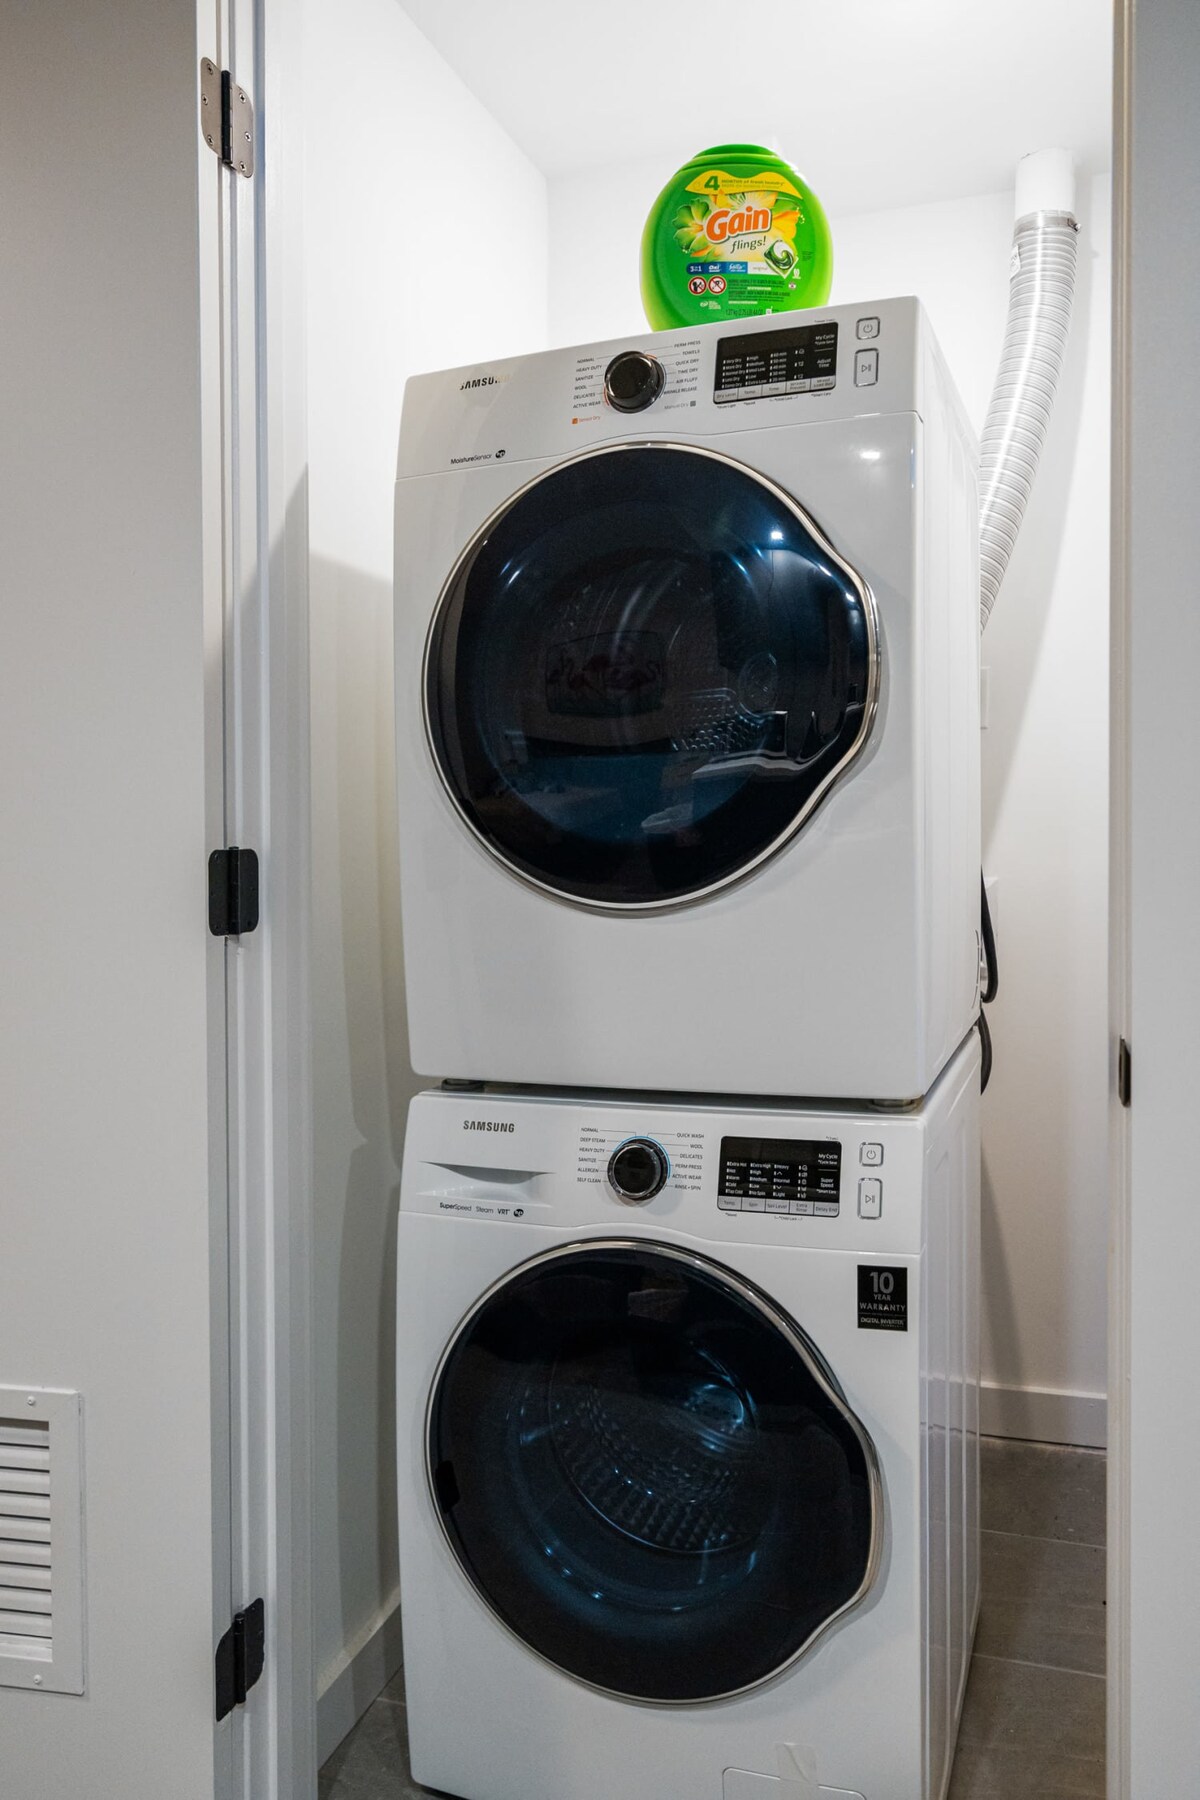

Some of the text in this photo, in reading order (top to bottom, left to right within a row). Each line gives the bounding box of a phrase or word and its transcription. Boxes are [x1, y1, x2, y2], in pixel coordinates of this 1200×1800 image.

[704, 176, 720, 190] 4
[706, 206, 770, 242] Gain
[730, 236, 767, 254] flings!
[450, 454, 493, 464] MoistureSensor
[463, 1120, 516, 1133] SAMSUNG
[440, 1202, 472, 1212] SuperSpeed
[475, 1205, 494, 1213] Steam
[870, 1271, 895, 1294] 10
[859, 1302, 906, 1312] WARRANTY
